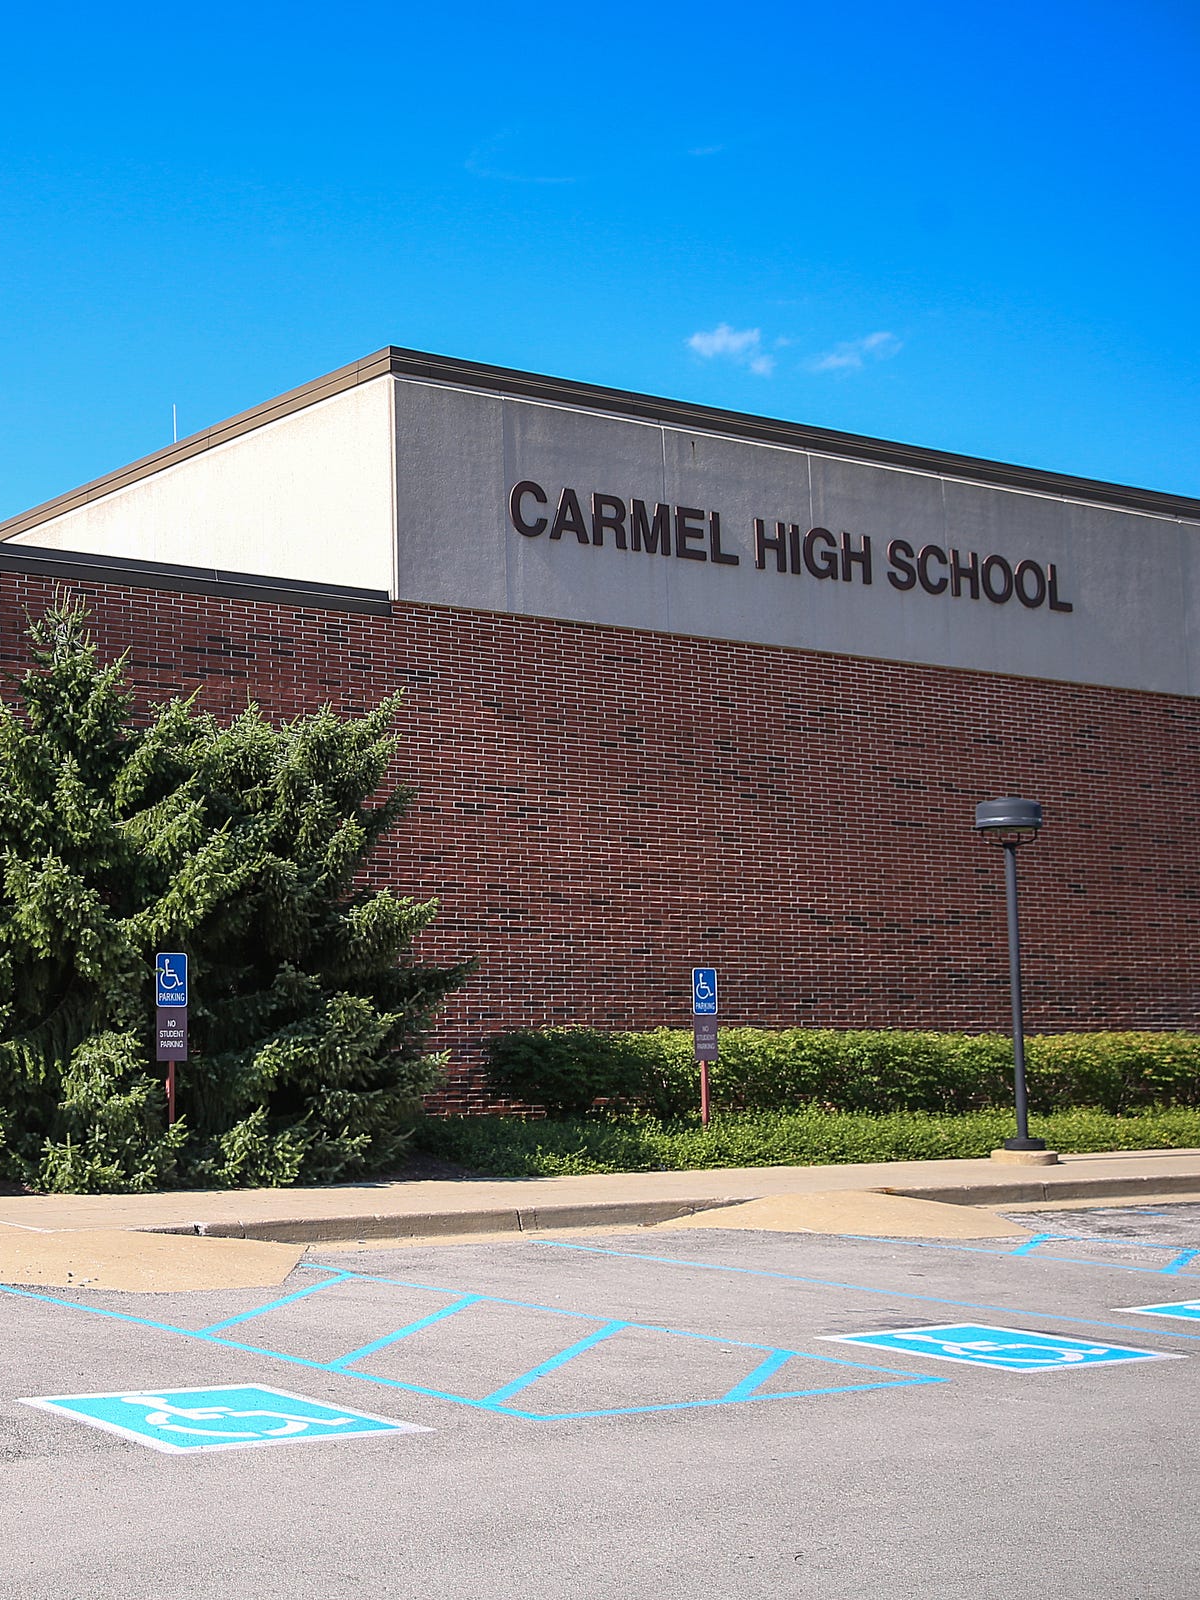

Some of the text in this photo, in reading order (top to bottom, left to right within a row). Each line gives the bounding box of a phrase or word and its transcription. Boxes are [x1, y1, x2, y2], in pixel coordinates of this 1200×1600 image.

[508, 480, 1073, 613] CARMEL HIGH SCHOOL
[159, 992, 185, 1002] PARKING
[695, 1002, 715, 1010] PARKING
[167, 1020, 176, 1028] NO
[159, 1030, 185, 1038] STUDENT
[160, 1040, 184, 1048] PARKING
